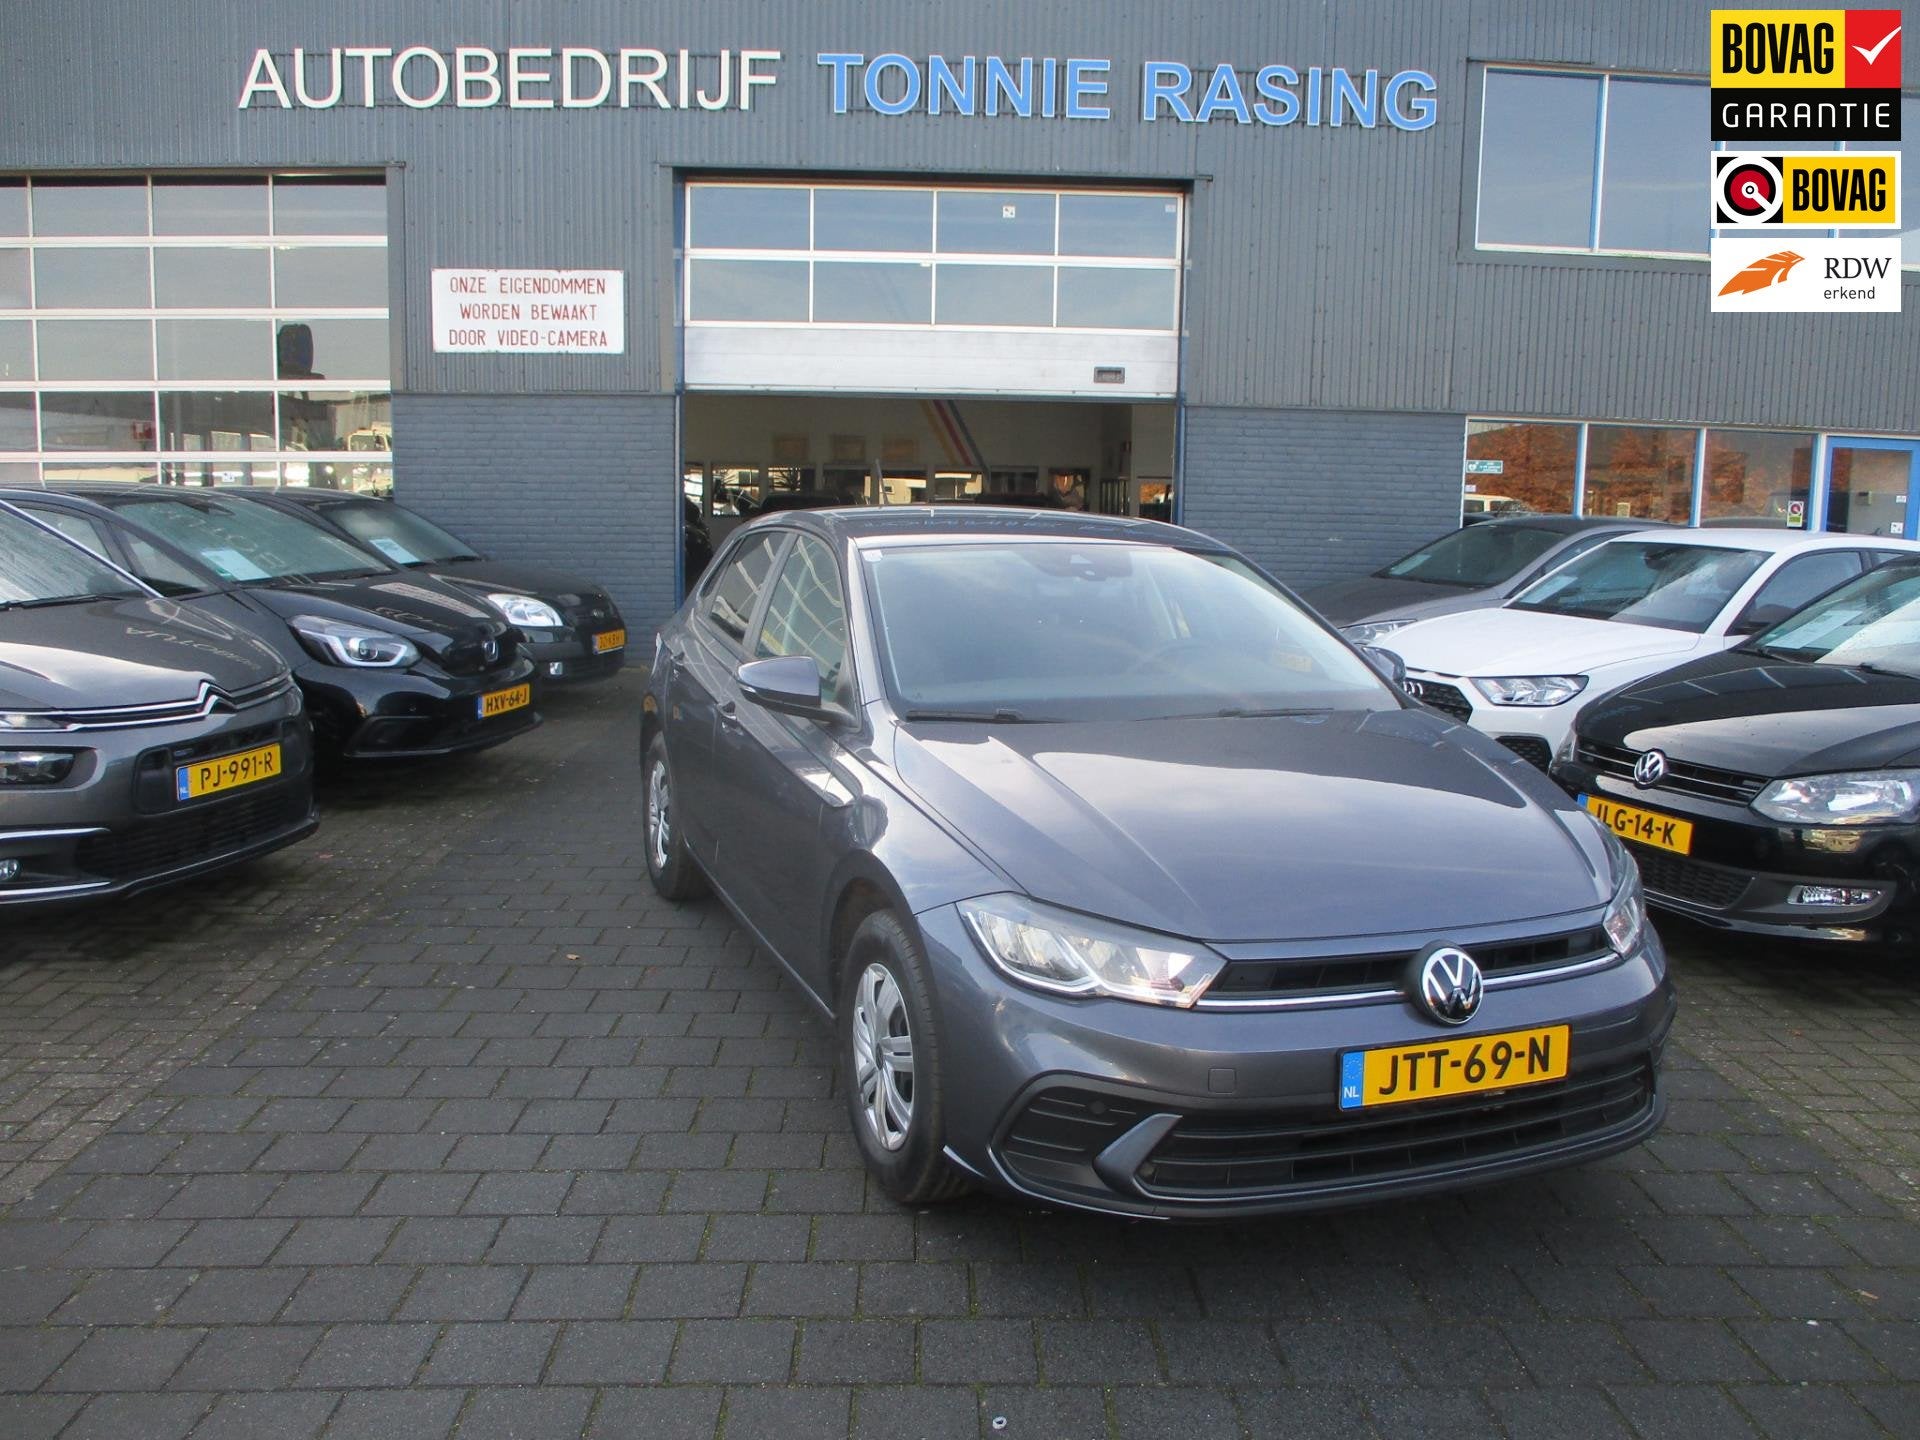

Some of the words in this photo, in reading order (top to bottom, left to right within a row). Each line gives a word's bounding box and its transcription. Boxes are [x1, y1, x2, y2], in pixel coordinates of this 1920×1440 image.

[239, 46, 782, 111] AUTOBEDRIJF
[817, 53, 1111, 120] TONNIE
[1143, 60, 1438, 132] RASING
[450, 276, 487, 294] ONZE
[500, 277, 606, 295] EIGENDOMMEN
[460, 303, 520, 320] WORDEN
[531, 304, 598, 321] BEWAAKT
[449, 329, 486, 346] DOOR
[498, 330, 608, 347] VIDEO-CAMERA
[486, 687, 527, 713] HXV-64-J
[200, 752, 273, 791] PJ-991-R
[1379, 1034, 1551, 1096] JTT-69-N
[1343, 1085, 1360, 1099] NL
